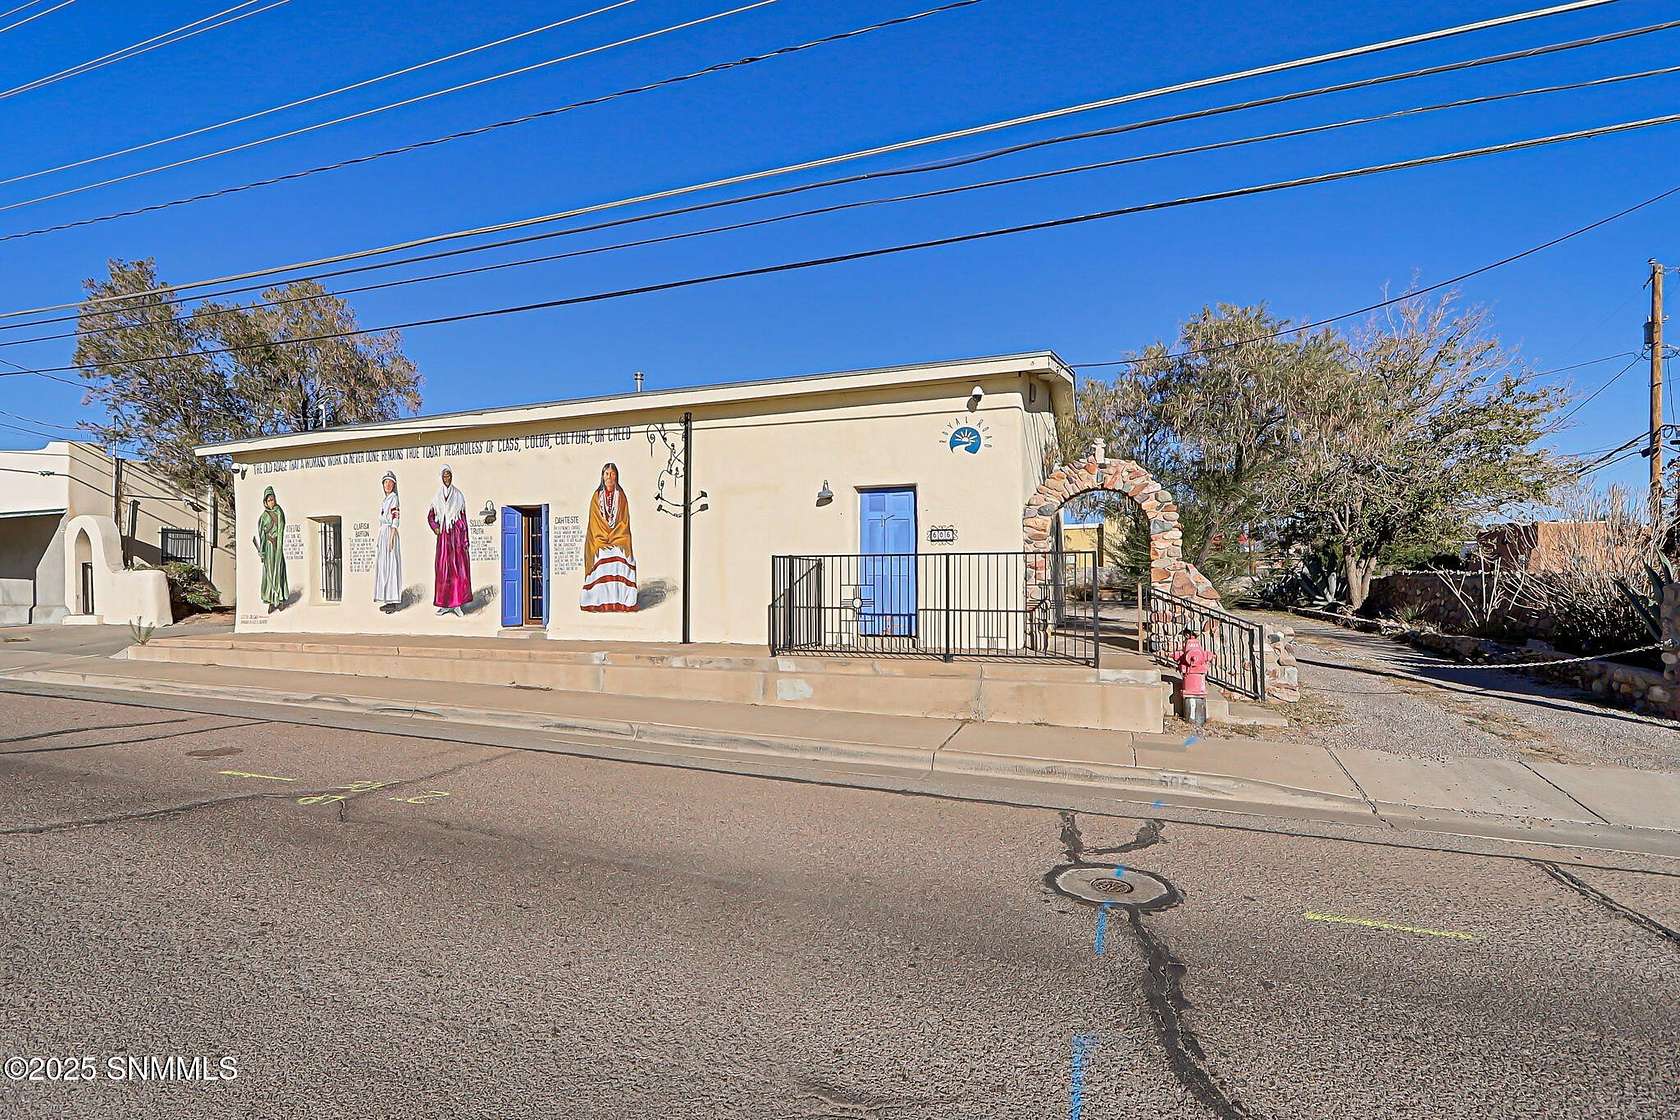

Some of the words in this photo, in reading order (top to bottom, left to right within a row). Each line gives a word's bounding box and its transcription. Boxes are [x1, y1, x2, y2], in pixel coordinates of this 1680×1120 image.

[253, 463, 263, 474] THE
[263, 462, 273, 473] OLD
[406, 447, 420, 459] TRUE
[422, 445, 442, 458] TODAY
[444, 441, 483, 456] REGARDLESS
[486, 440, 495, 454] OF
[497, 437, 521, 452] CLASS,
[524, 433, 553, 449] COLOR,
[555, 429, 593, 446] CULTURE,
[594, 428, 605, 443] OR
[608, 426, 631, 442] CREED
[933, 531, 951, 539] 606
